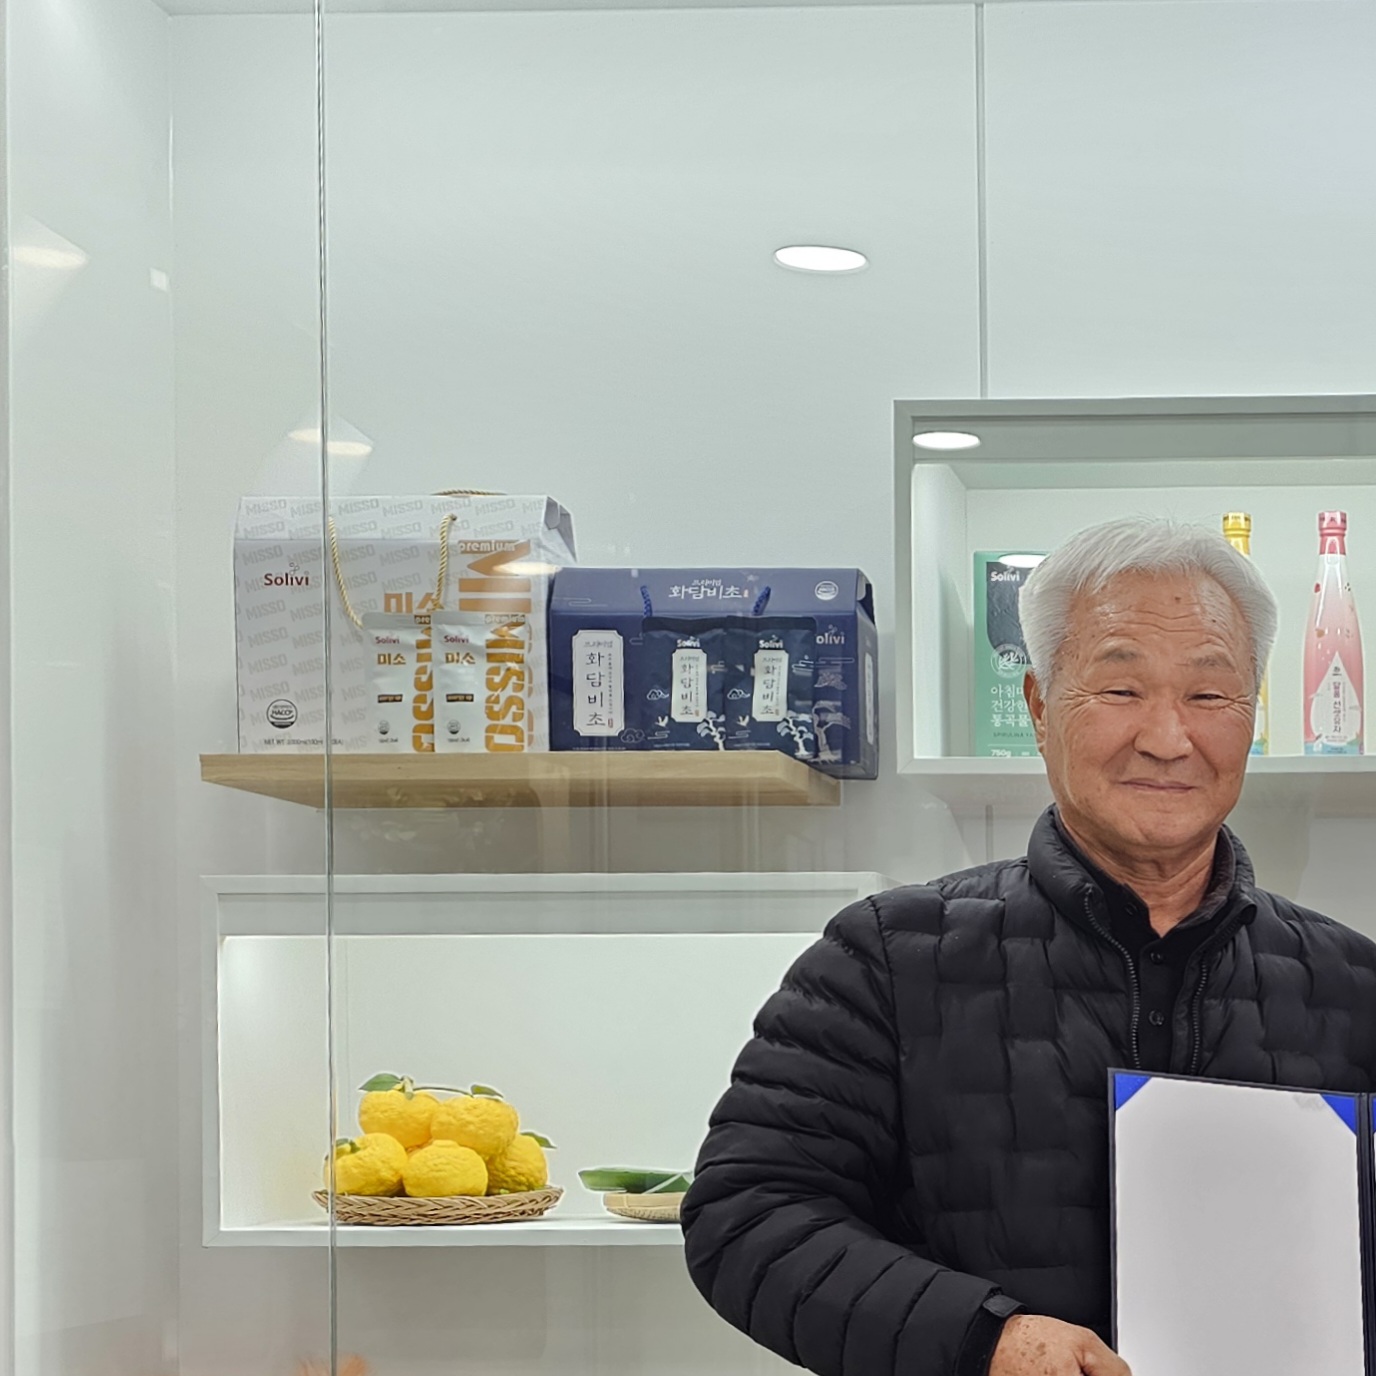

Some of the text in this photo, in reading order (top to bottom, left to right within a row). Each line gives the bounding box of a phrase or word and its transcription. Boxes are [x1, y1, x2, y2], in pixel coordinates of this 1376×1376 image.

[458, 540, 516, 553] premium
[263, 571, 310, 587] Solivi
[990, 570, 1020, 582] Solivi
[668, 585, 743, 600] 화담비초
[375, 635, 400, 645] Solivi
[444, 635, 470, 644] Solivi
[676, 638, 700, 648] Solivi
[758, 639, 783, 649] Solivi
[816, 631, 845, 645] olivi
[377, 653, 406, 665] 미소
[445, 652, 475, 665] 미소
[585, 652, 606, 727] 화담비초
